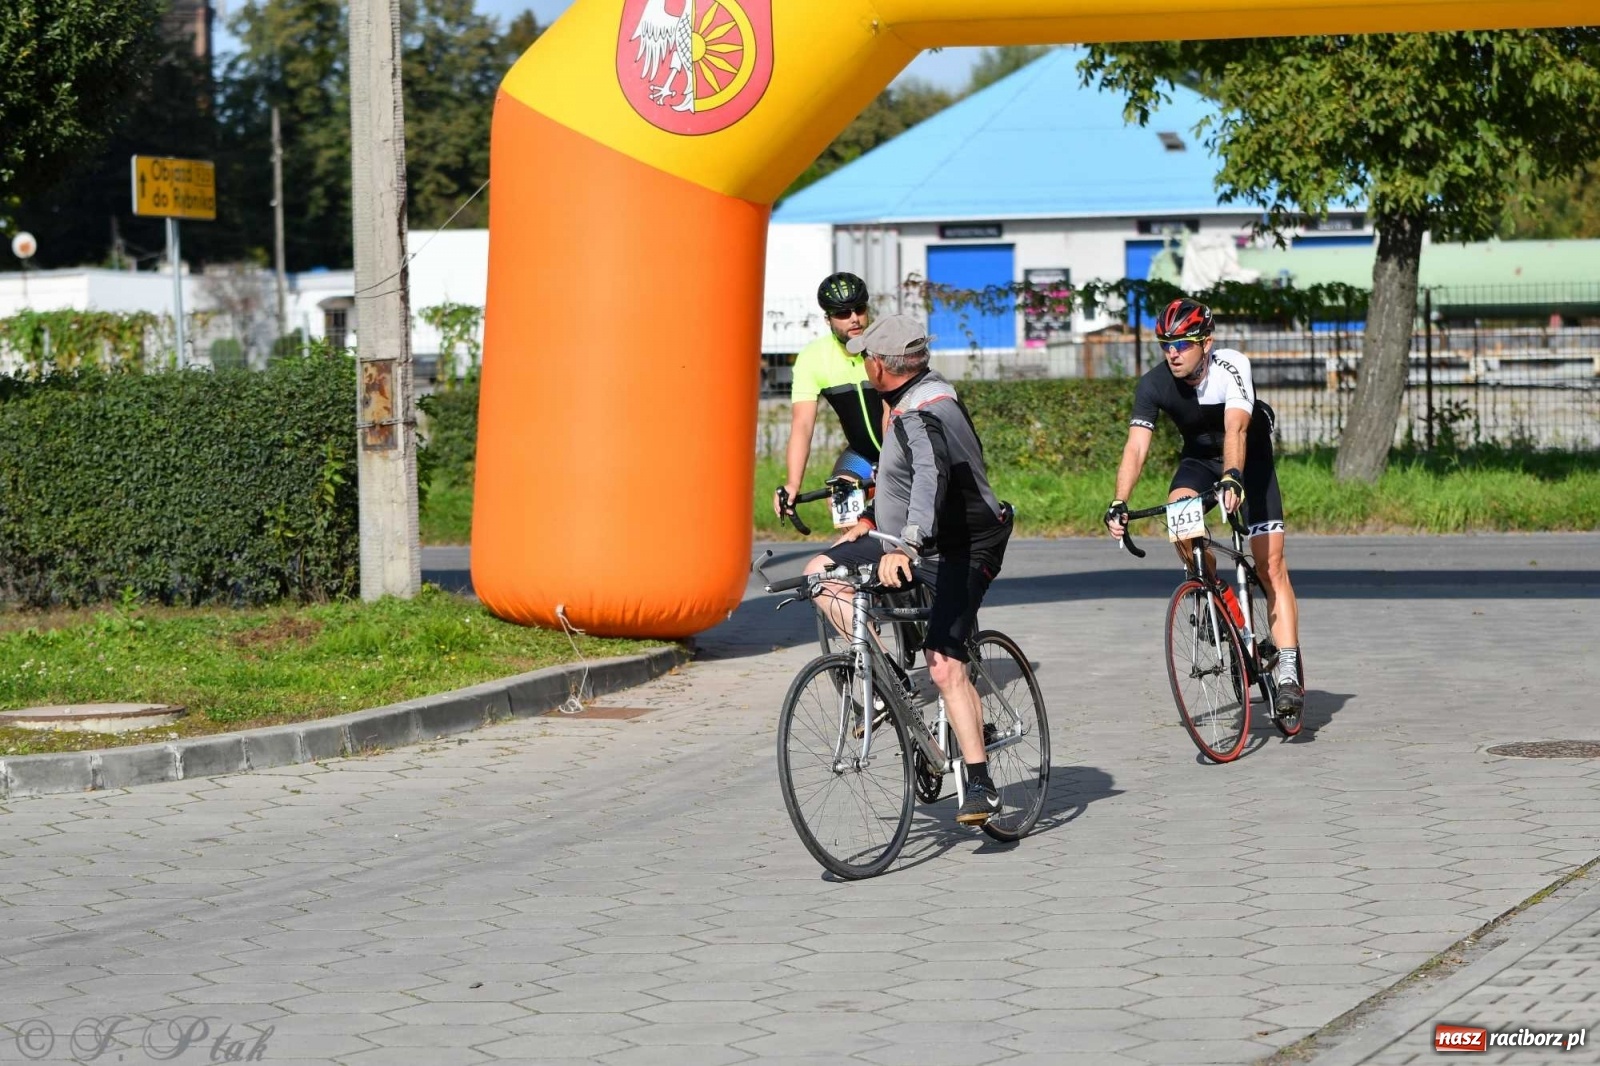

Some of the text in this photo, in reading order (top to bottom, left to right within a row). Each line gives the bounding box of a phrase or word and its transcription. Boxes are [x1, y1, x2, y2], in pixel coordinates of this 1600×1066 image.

[151, 159, 193, 187] Objazd
[153, 187, 169, 207] do
[1170, 510, 1201, 527] 1513
